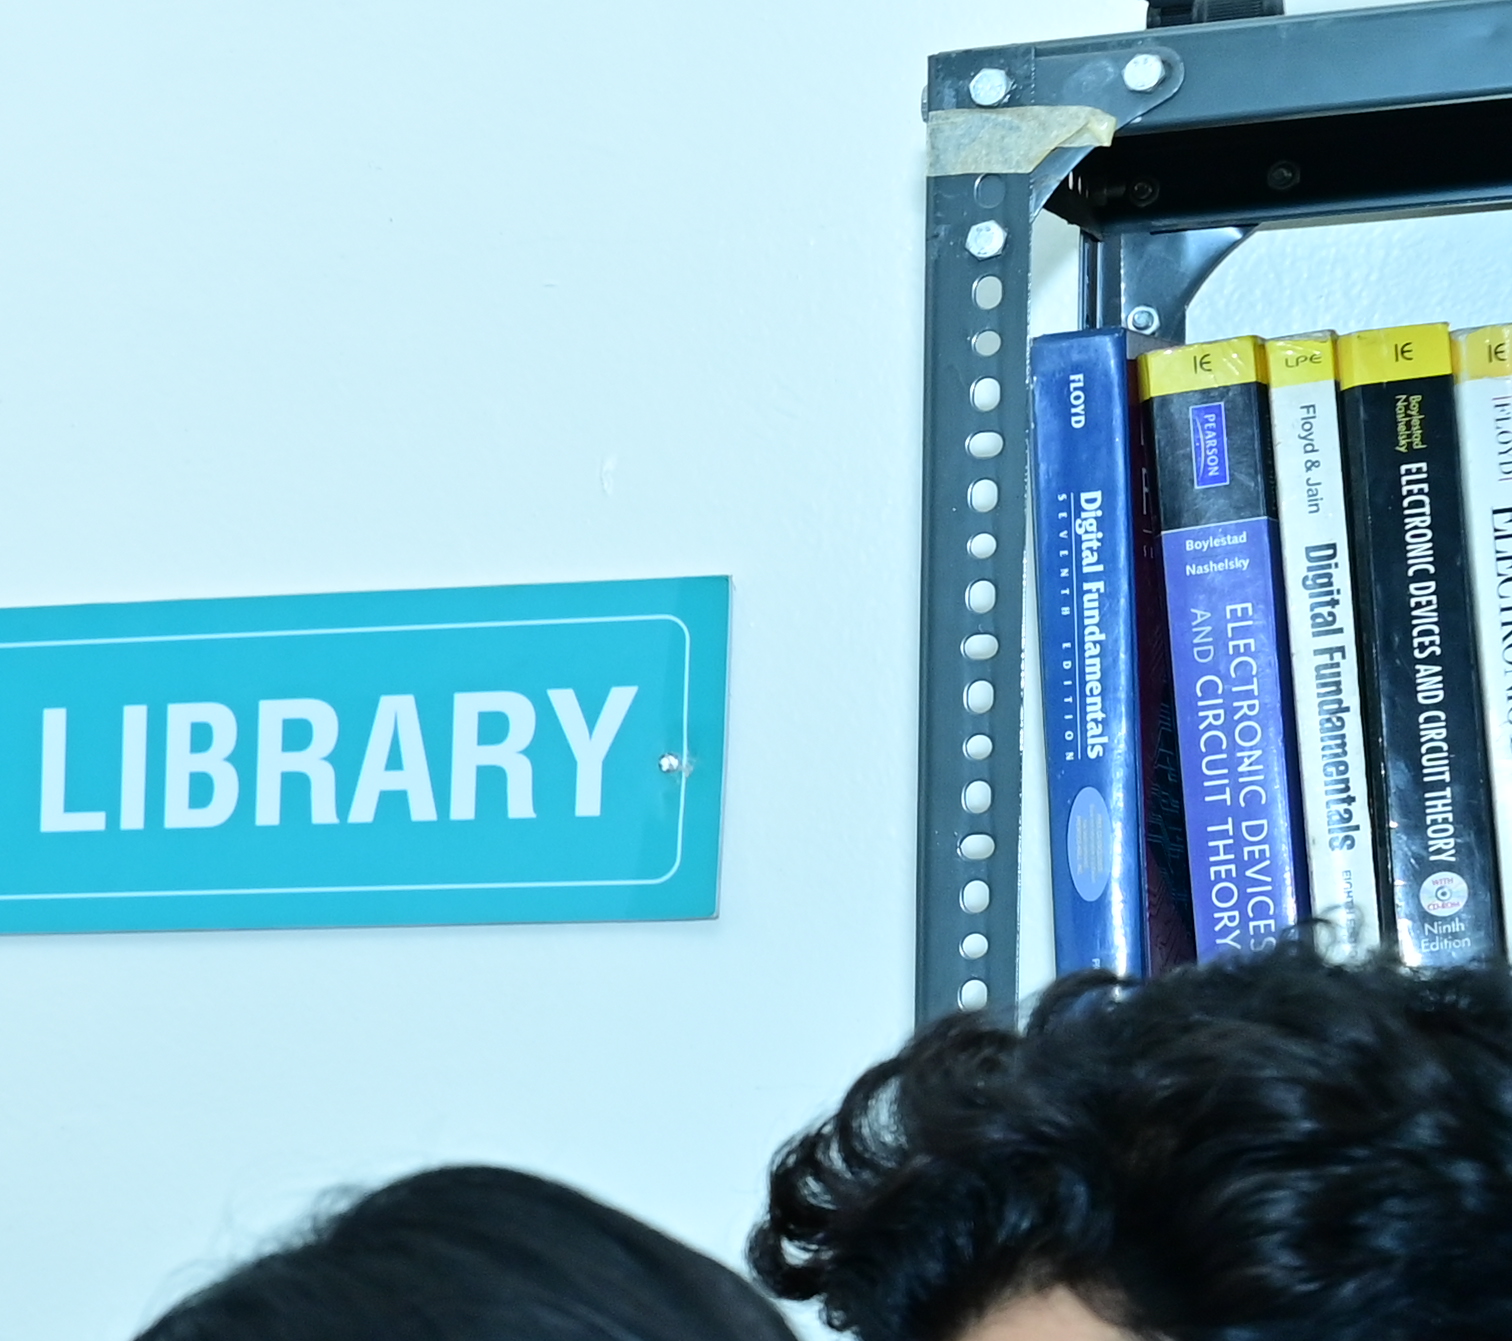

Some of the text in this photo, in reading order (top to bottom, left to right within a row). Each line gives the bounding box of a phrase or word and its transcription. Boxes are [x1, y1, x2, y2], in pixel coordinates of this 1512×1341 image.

[1069, 373, 1085, 429] FLOYD
[1203, 413, 1221, 477] PEARSON
[1298, 404, 1324, 515] Floyd & Jain
[1185, 531, 1248, 552] Boylestad
[1185, 557, 1250, 576] Nashelsky
[1057, 493, 1075, 761] SEVENTH EDITION
[1076, 490, 1109, 760] Digital Fundamentals
[1400, 462, 1457, 863] ELECTRONIC DEVICES AND CIRCUIT THEORY
[39, 684, 640, 834] LIBRARY
[1302, 542, 1361, 854] Digital Fundamentals
[1190, 607, 1242, 951] AND CIRCUIT THEORY
[1225, 602, 1278, 952] ELECTRONIC DEVICES
[1421, 935, 1471, 952] Edition
[1424, 917, 1466, 936] Ninth
